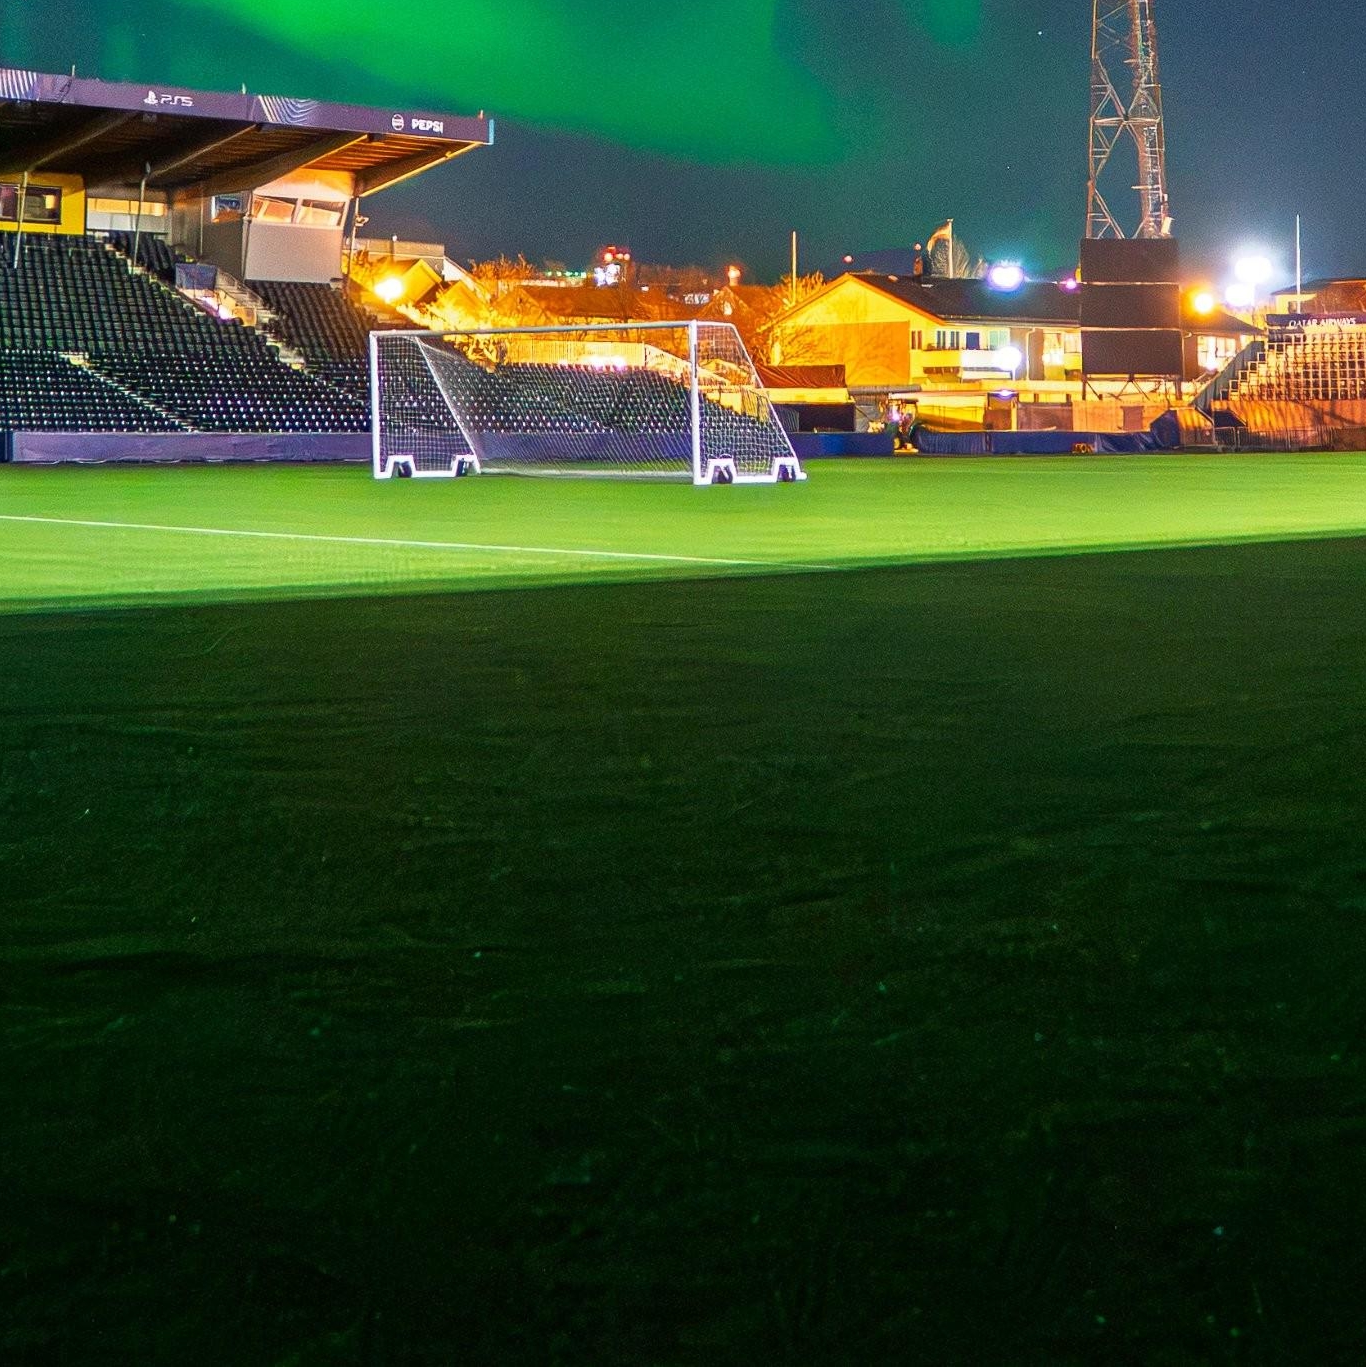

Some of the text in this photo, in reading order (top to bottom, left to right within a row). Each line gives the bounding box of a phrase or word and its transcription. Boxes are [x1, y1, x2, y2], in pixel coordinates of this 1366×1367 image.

[160, 94, 194, 107] PS5
[411, 118, 444, 134] PEPSI
[1289, 319, 1317, 328] QATAR
